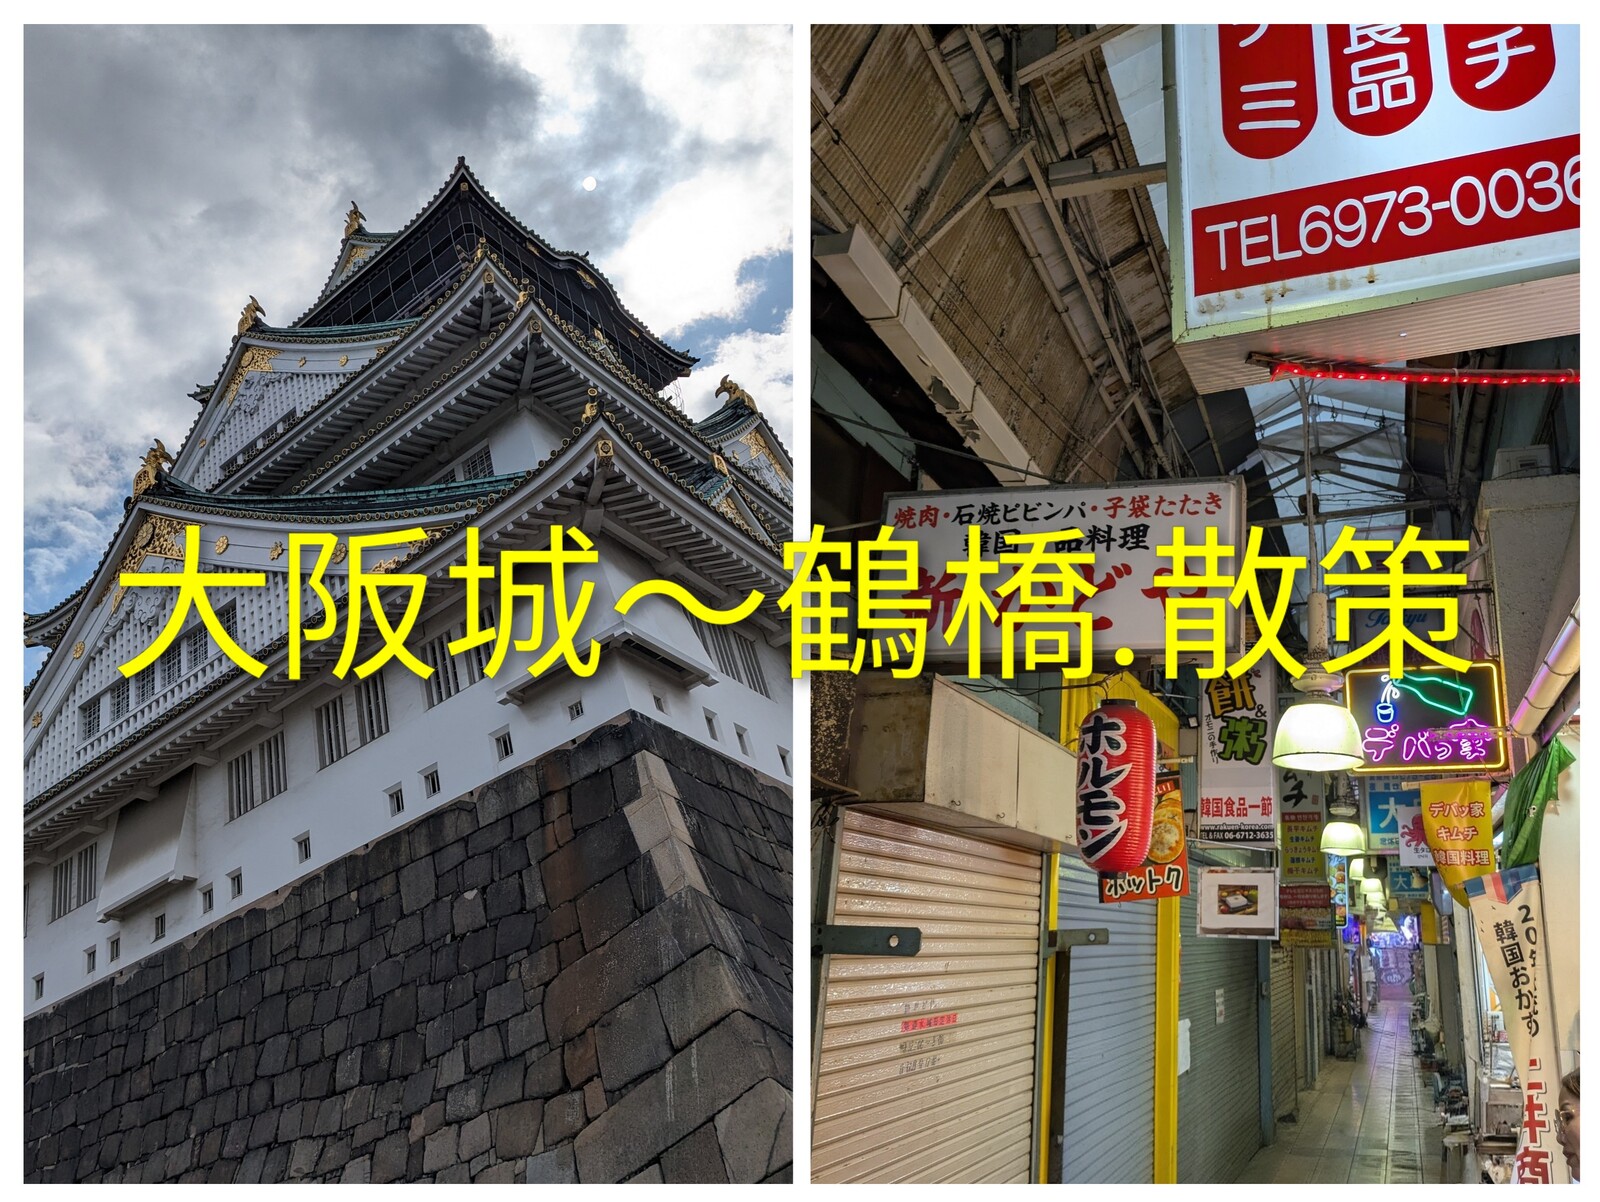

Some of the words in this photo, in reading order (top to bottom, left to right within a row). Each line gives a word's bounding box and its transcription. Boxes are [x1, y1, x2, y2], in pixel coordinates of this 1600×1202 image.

[1077, 713, 1135, 862] ホルモン
[1224, 831, 1274, 839] 06-6712-3635
[1437, 827, 1478, 841] キムチ
